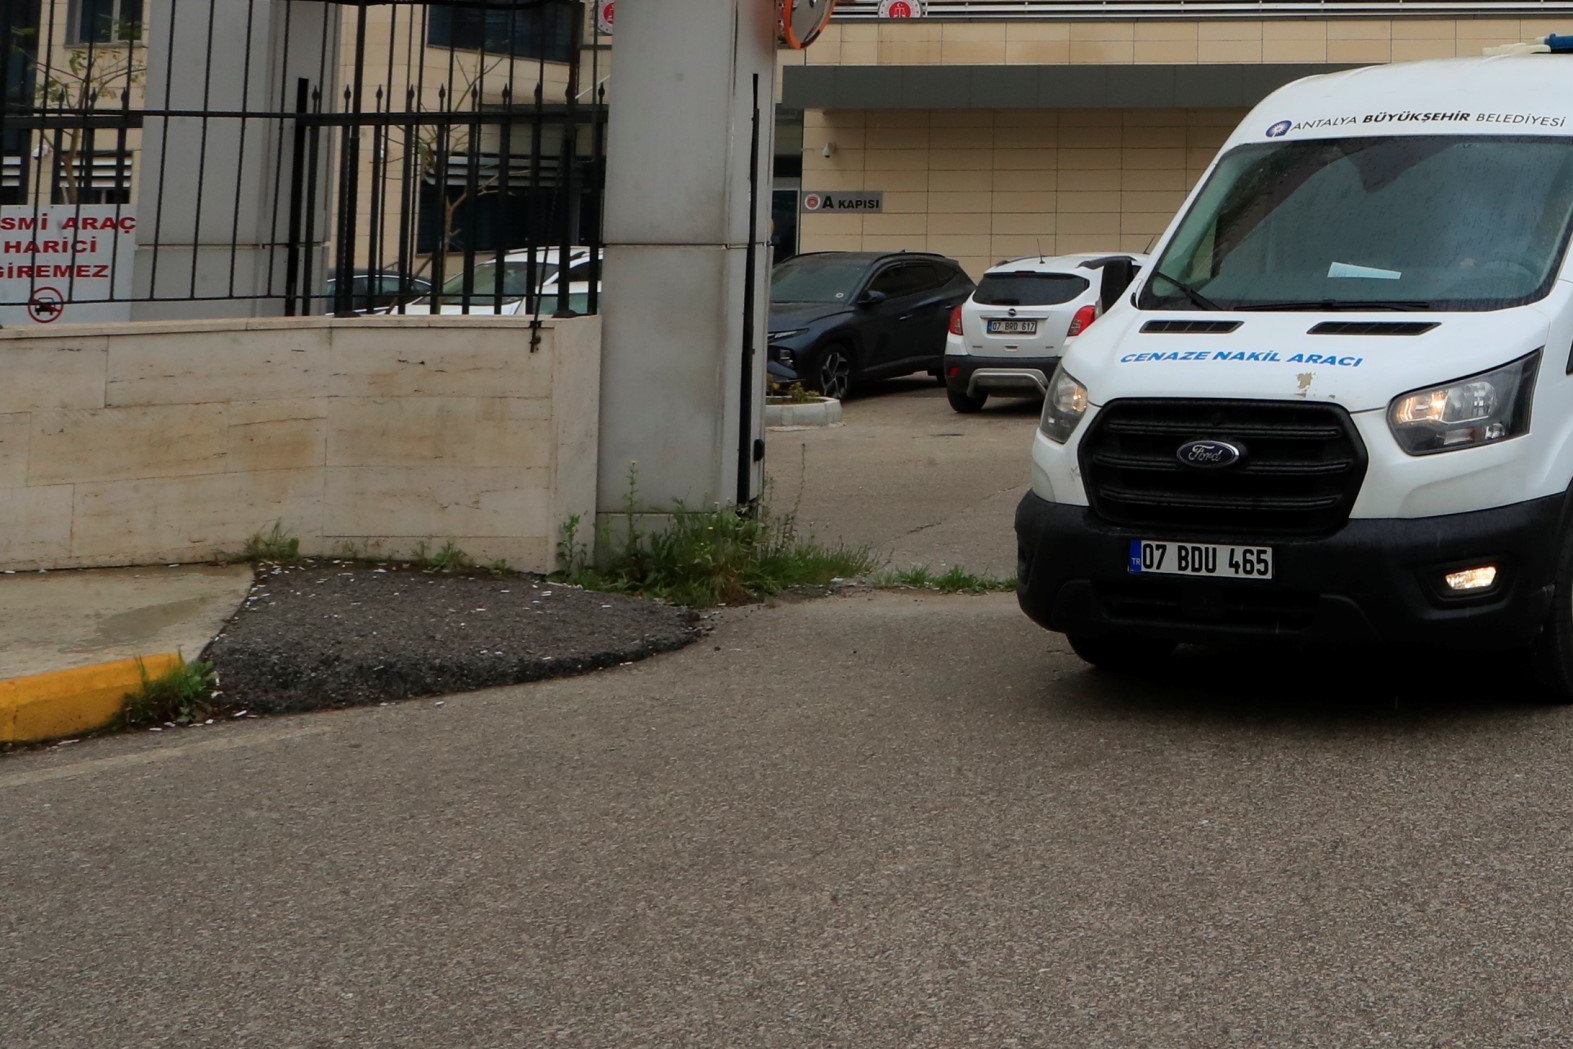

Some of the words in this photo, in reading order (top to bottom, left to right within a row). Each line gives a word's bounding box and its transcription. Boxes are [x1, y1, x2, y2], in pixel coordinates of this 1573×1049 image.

[1290, 116, 1357, 131] ANTALYA
[1362, 110, 1471, 124] BÜYÜKŞEHİR
[1475, 112, 1567, 128] BELEDİYESİ
[822, 195, 834, 209] A
[838, 199, 880, 209] KAPISI
[61, 216, 136, 234] ARAÇ
[4, 236, 97, 254] HARİCİ
[992, 322, 1001, 331] 07
[1021, 322, 1035, 331] 617
[1120, 350, 1211, 363] CENAZE
[1212, 349, 1280, 362] NAKİL
[1286, 352, 1364, 368] ARACI
[1188, 444, 1223, 462] Ford
[1132, 557, 1141, 566] TR
[1142, 543, 1167, 571] 07
[1177, 545, 1217, 574] BDU
[1228, 548, 1269, 576] 465
